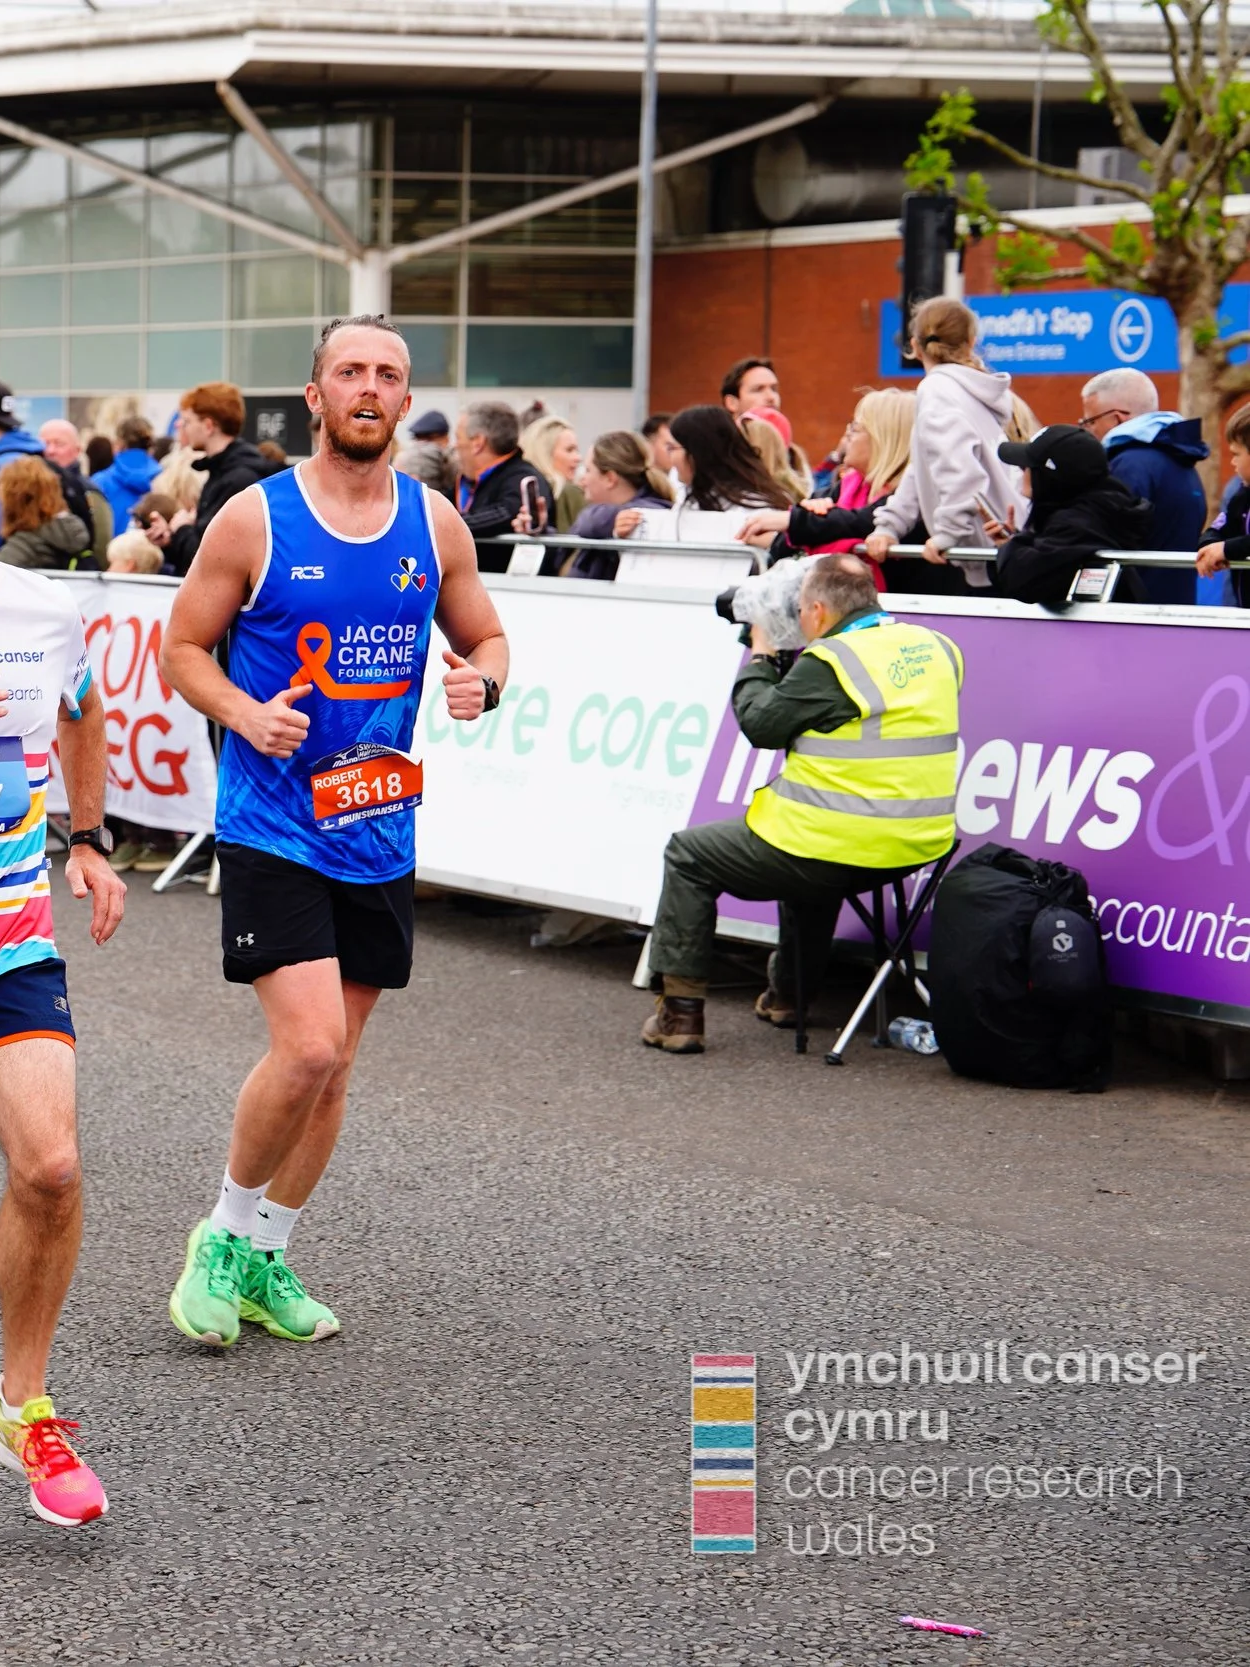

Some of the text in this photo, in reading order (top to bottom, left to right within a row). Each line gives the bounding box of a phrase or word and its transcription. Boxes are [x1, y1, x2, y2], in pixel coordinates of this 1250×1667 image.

[291, 566, 325, 580] RCS
[339, 624, 418, 643] JACOB
[338, 645, 415, 665] CRANE
[338, 666, 412, 678] FOUNDATION
[568, 692, 709, 777] core
[314, 768, 363, 790] ROBERT
[336, 773, 403, 809] 3618
[338, 802, 404, 827] #RUNSWANSEA
